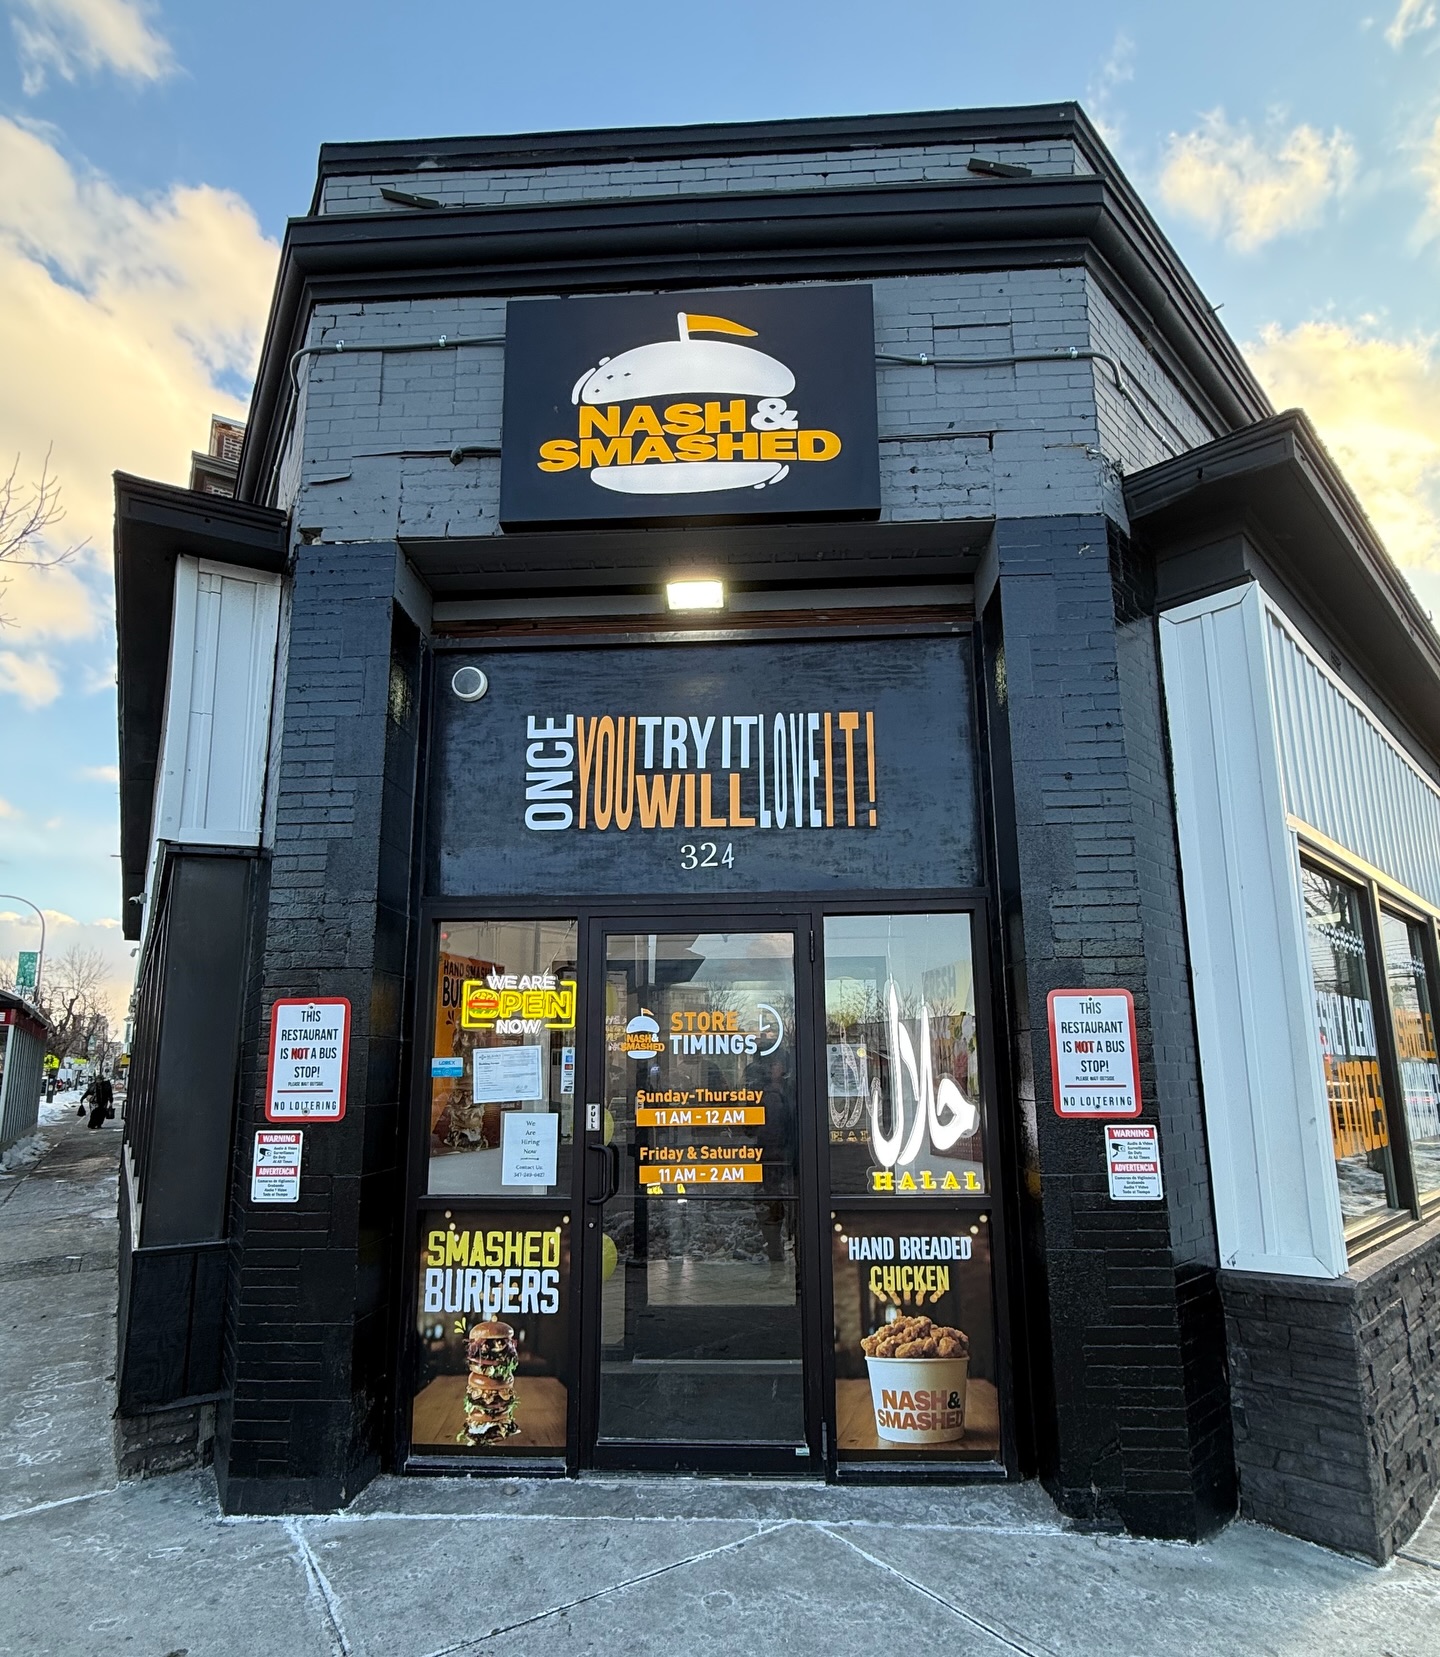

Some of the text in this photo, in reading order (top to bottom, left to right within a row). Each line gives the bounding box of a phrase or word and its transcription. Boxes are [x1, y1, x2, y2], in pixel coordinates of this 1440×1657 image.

[536, 429, 842, 473] SMASHED
[524, 714, 758, 831] ONCE YOU TRY IT
[758, 711, 877, 830] LOVE IT!
[636, 773, 756, 828] WILL
[680, 842, 735, 870] 324
[487, 974, 556, 990] WE ARE
[1079, 1002, 1102, 1014] THIS
[301, 1010, 321, 1022] THIS
[670, 1011, 738, 1032] STORE
[496, 1019, 541, 1034] NOW
[1061, 1021, 1124, 1034] RESTAURANT
[281, 1028, 339, 1041] RESTAURANT
[620, 1042, 665, 1052] SMASHED
[669, 1033, 758, 1055] TIMINGS
[1062, 1040, 1125, 1054] IS NOT A BUS
[280, 1047, 337, 1060] IS NOT A BUS
[294, 1066, 320, 1078] STOP!
[1080, 1060, 1110, 1073] STOP!
[636, 1088, 763, 1105] Sunday-Thursday
[1063, 1096, 1133, 1107] NO LOITERING
[273, 1100, 337, 1111] NO LOITERING
[654, 1111, 667, 1125] 11
[669, 1111, 692, 1124] AM
[705, 1110, 720, 1124] 12
[722, 1110, 745, 1123] AM
[262, 1134, 296, 1143] WARNING
[1113, 1129, 1150, 1138] WARNING
[639, 1145, 763, 1163] Friday & Saturday
[258, 1167, 295, 1176] ADVERTENCIA
[658, 1168, 671, 1182] 11
[673, 1168, 697, 1182] AM
[709, 1168, 718, 1181] 2
[720, 1167, 745, 1181] AM
[1114, 1163, 1155, 1172] ADVERTENCIA
[872, 1170, 981, 1191] HALAL
[427, 1230, 560, 1268] SMASHED
[848, 1236, 972, 1260] HAND BREADED
[869, 1265, 950, 1291] CHICKEN
[424, 1268, 559, 1314] BURGERS
[877, 1410, 963, 1431] SMASHED
